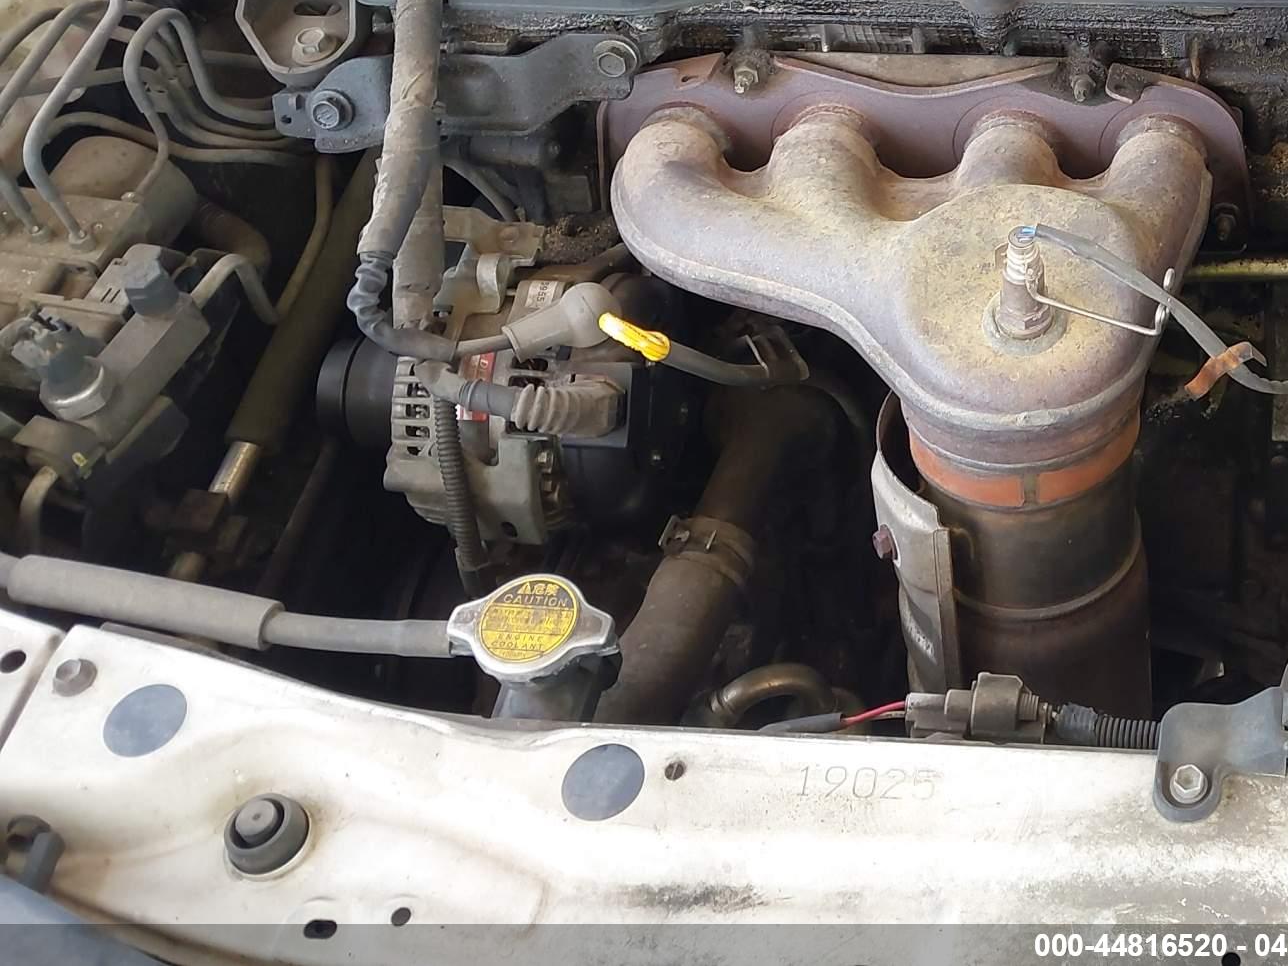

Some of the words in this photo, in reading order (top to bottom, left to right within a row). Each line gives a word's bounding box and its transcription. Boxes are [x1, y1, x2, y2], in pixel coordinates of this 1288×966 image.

[503, 594, 568, 607] CAUTION
[496, 633, 544, 643] ENGINE
[491, 641, 545, 650] COOLANT
[797, 765, 937, 801] 19025
